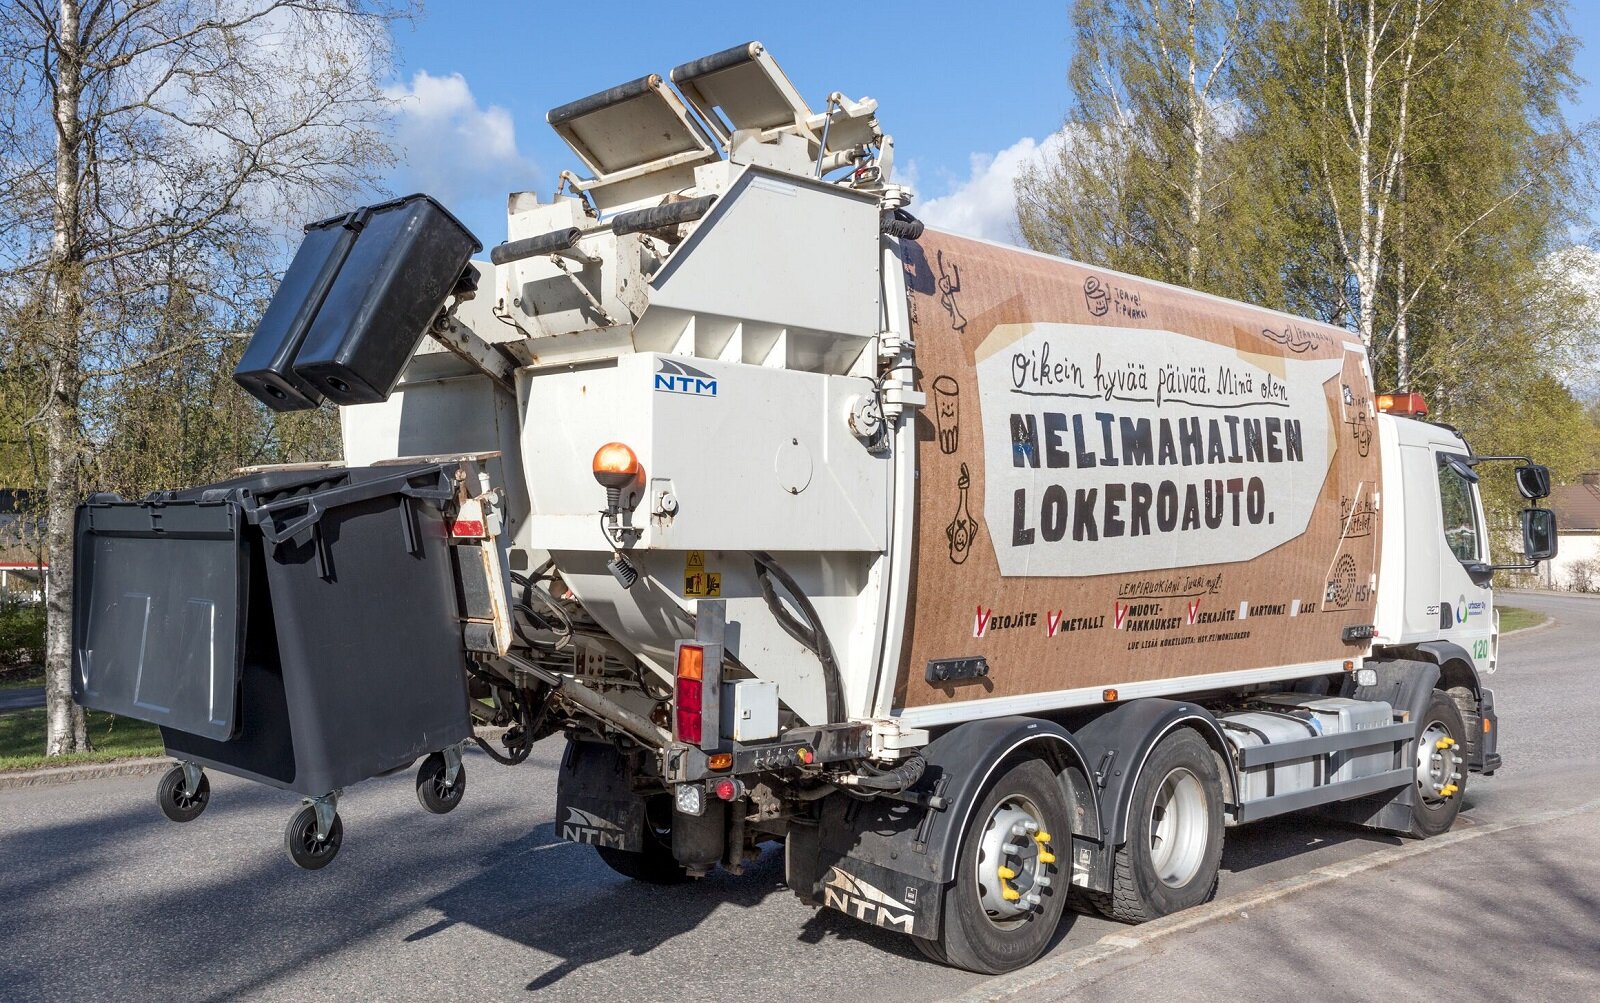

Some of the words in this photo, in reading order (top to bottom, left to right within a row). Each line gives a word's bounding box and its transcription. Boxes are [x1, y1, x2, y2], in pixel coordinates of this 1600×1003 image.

[1012, 341, 1084, 388] Oikein
[1094, 353, 1147, 401] hyvää
[1157, 364, 1210, 408] päivää.
[1217, 366, 1252, 396] Minä
[1261, 373, 1288, 400] olen
[655, 374, 717, 395] NTM
[1010, 412, 1303, 468] NELIMAHAINEN
[1012, 476, 1274, 546] LOKEROAUTO.
[1355, 584, 1372, 602] HSY
[1128, 603, 1163, 617] MUOVI-
[1197, 608, 1236, 624] SEKAJÄTE
[1249, 604, 1286, 616] KARTONKI
[1300, 602, 1316, 614] LASI
[990, 611, 1037, 631] BIOJÄTE
[1061, 615, 1105, 632] METALLI
[1126, 617, 1182, 632] PAKKAUKSET
[1127, 641, 1139, 650] LUE
[1141, 638, 1158, 649] LISÄÄ
[1473, 639, 1488, 659] 120
[562, 824, 625, 850] NTM
[824, 886, 915, 935] NTM
